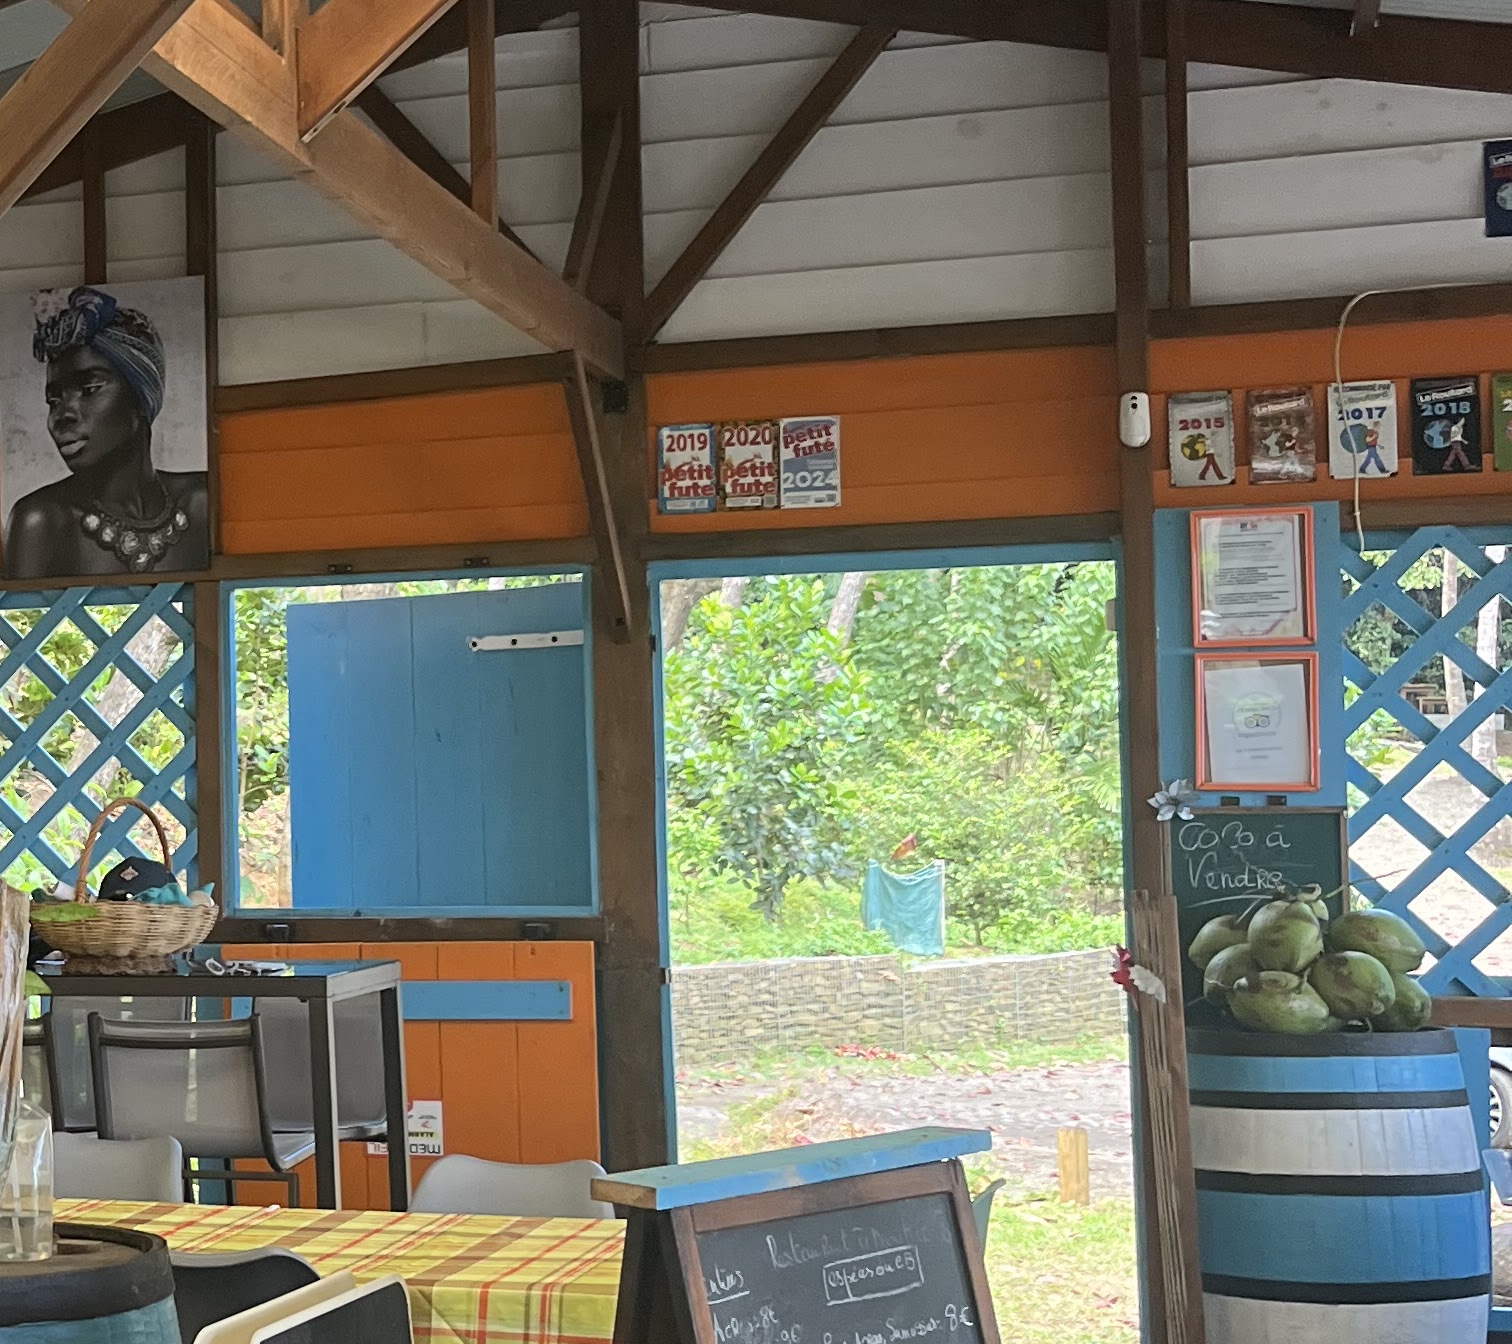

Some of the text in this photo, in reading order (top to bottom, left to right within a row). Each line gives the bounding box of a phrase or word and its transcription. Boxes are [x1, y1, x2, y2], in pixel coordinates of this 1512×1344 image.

[1338, 406, 1388, 422] 2017
[1420, 401, 1472, 417] 2018
[1178, 417, 1226, 432] 2015
[665, 432, 709, 453] 2019
[723, 425, 774, 448] 2020
[782, 424, 833, 450] petit
[660, 463, 715, 486] petit
[721, 461, 777, 484] petit
[782, 470, 838, 489] 2024
